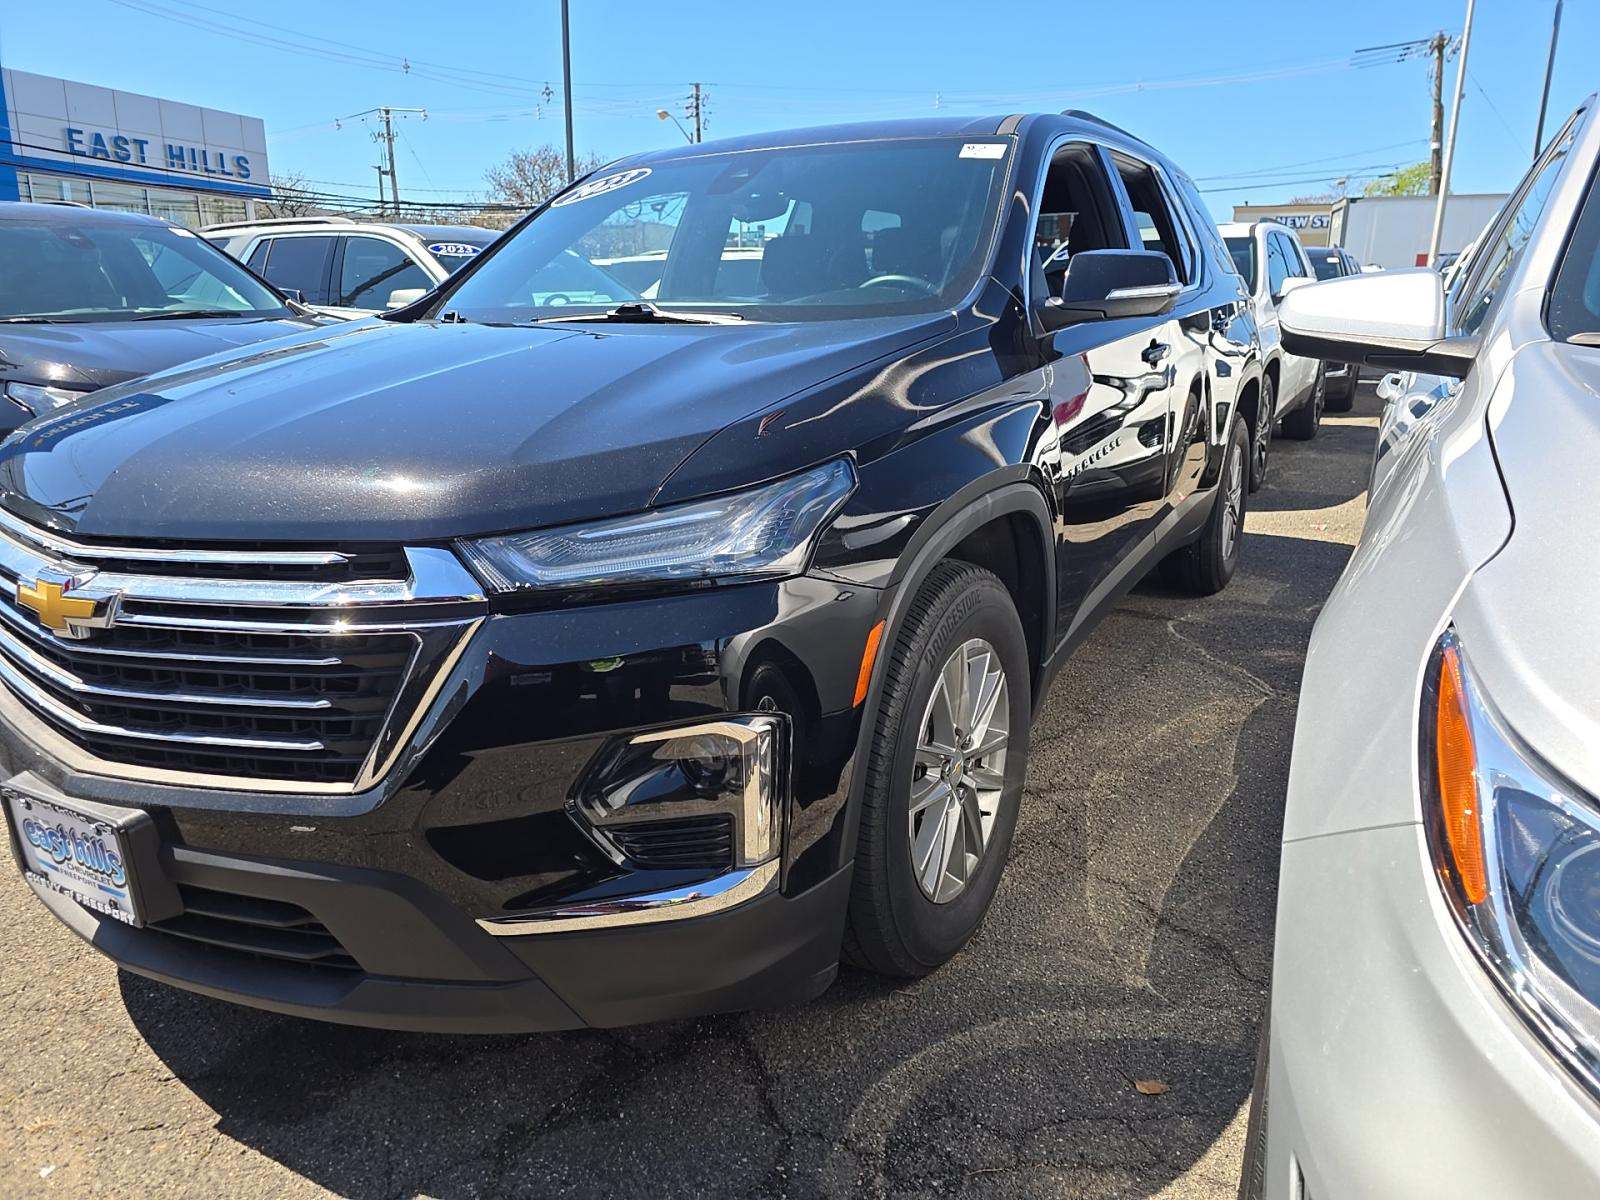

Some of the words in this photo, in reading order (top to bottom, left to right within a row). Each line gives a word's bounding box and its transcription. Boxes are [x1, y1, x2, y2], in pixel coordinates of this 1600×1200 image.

[66, 127, 149, 165] EAST
[166, 144, 251, 179] HILLS
[438, 245, 474, 254] 2023
[924, 589, 982, 670] BRIDGESTONE
[23, 818, 72, 863] east
[69, 827, 127, 887] hills
[75, 892, 136, 926] FREEPORT
